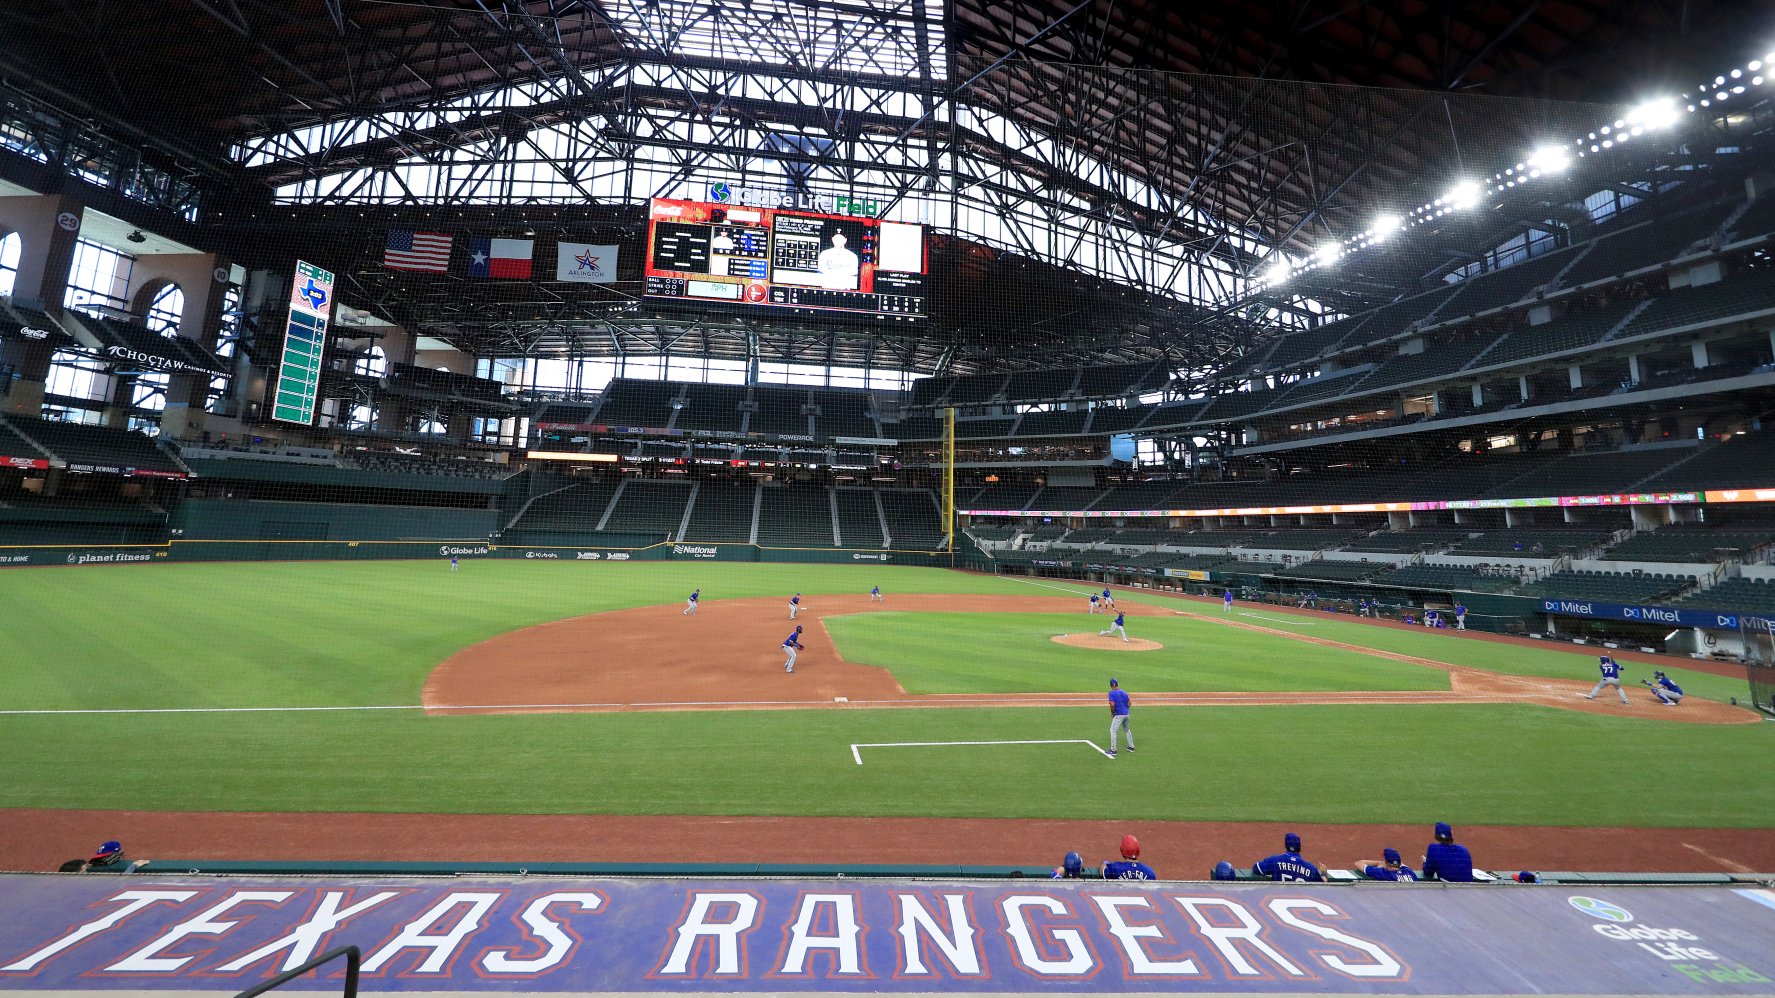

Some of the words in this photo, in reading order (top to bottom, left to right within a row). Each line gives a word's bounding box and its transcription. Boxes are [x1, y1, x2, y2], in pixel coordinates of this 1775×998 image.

[737, 187, 794, 208] Globe
[798, 193, 833, 211] Life
[836, 196, 878, 216] Field
[60, 214, 77, 229] 29
[216, 270, 226, 280] 10
[568, 270, 605, 278] ARLINGTON
[116, 346, 185, 370] CHOCTAW
[70, 463, 94, 471] RANGERS
[94, 465, 120, 473] REWARDS
[450, 546, 473, 555] Globe
[474, 546, 488, 555] Life
[682, 545, 717, 555] National
[78, 553, 114, 564] planet
[115, 552, 151, 562] fitness
[1561, 601, 1593, 614] Mitel
[1642, 608, 1681, 622] Mitel
[1602, 666, 1614, 674] 77
[1277, 861, 1311, 877] TREVINO
[2, 889, 604, 974] TEXAS
[660, 892, 1402, 977] RANGERS
[1592, 923, 1699, 941] Globe
[1636, 941, 1720, 961] Life
[1670, 962, 1774, 984] Field
